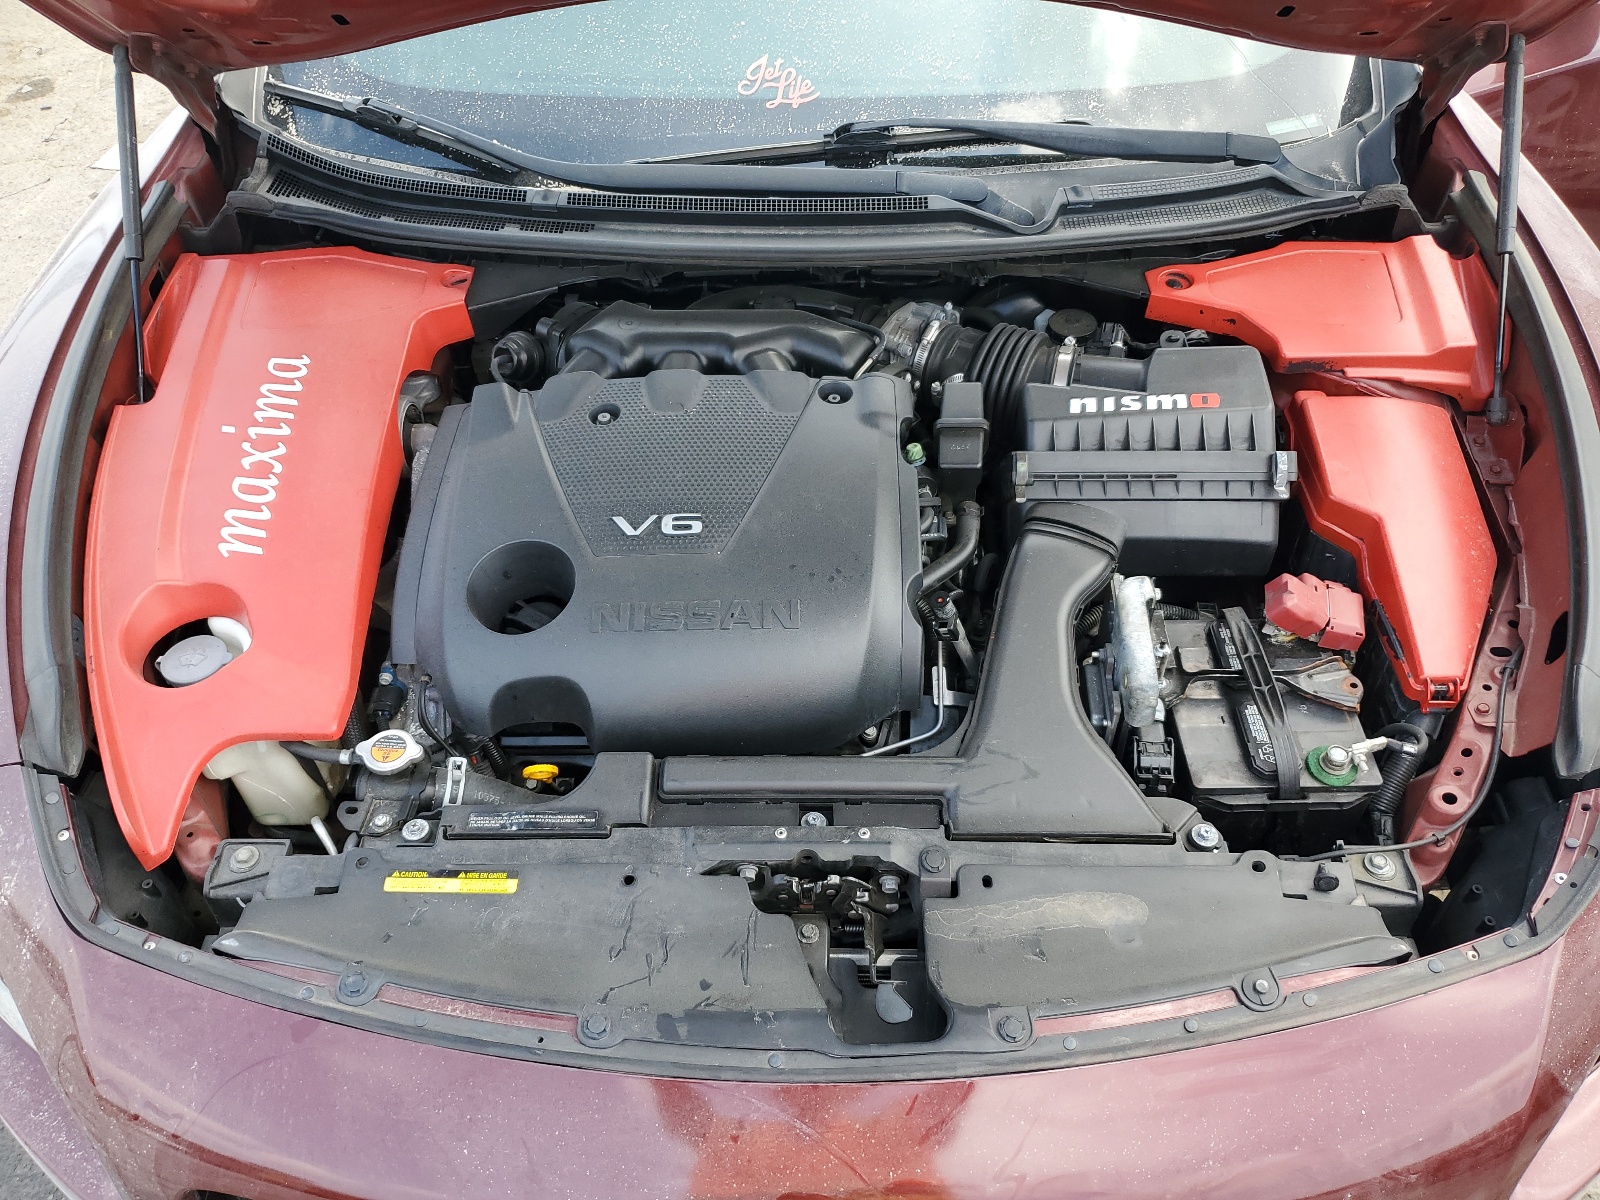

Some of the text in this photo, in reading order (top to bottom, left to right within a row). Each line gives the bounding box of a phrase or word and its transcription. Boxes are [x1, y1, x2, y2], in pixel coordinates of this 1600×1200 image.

[762, 67, 821, 109] Life
[1069, 392, 1221, 414] nismo
[217, 354, 311, 558] maxima
[610, 513, 703, 537] V6
[590, 599, 801, 633] NISSAN
